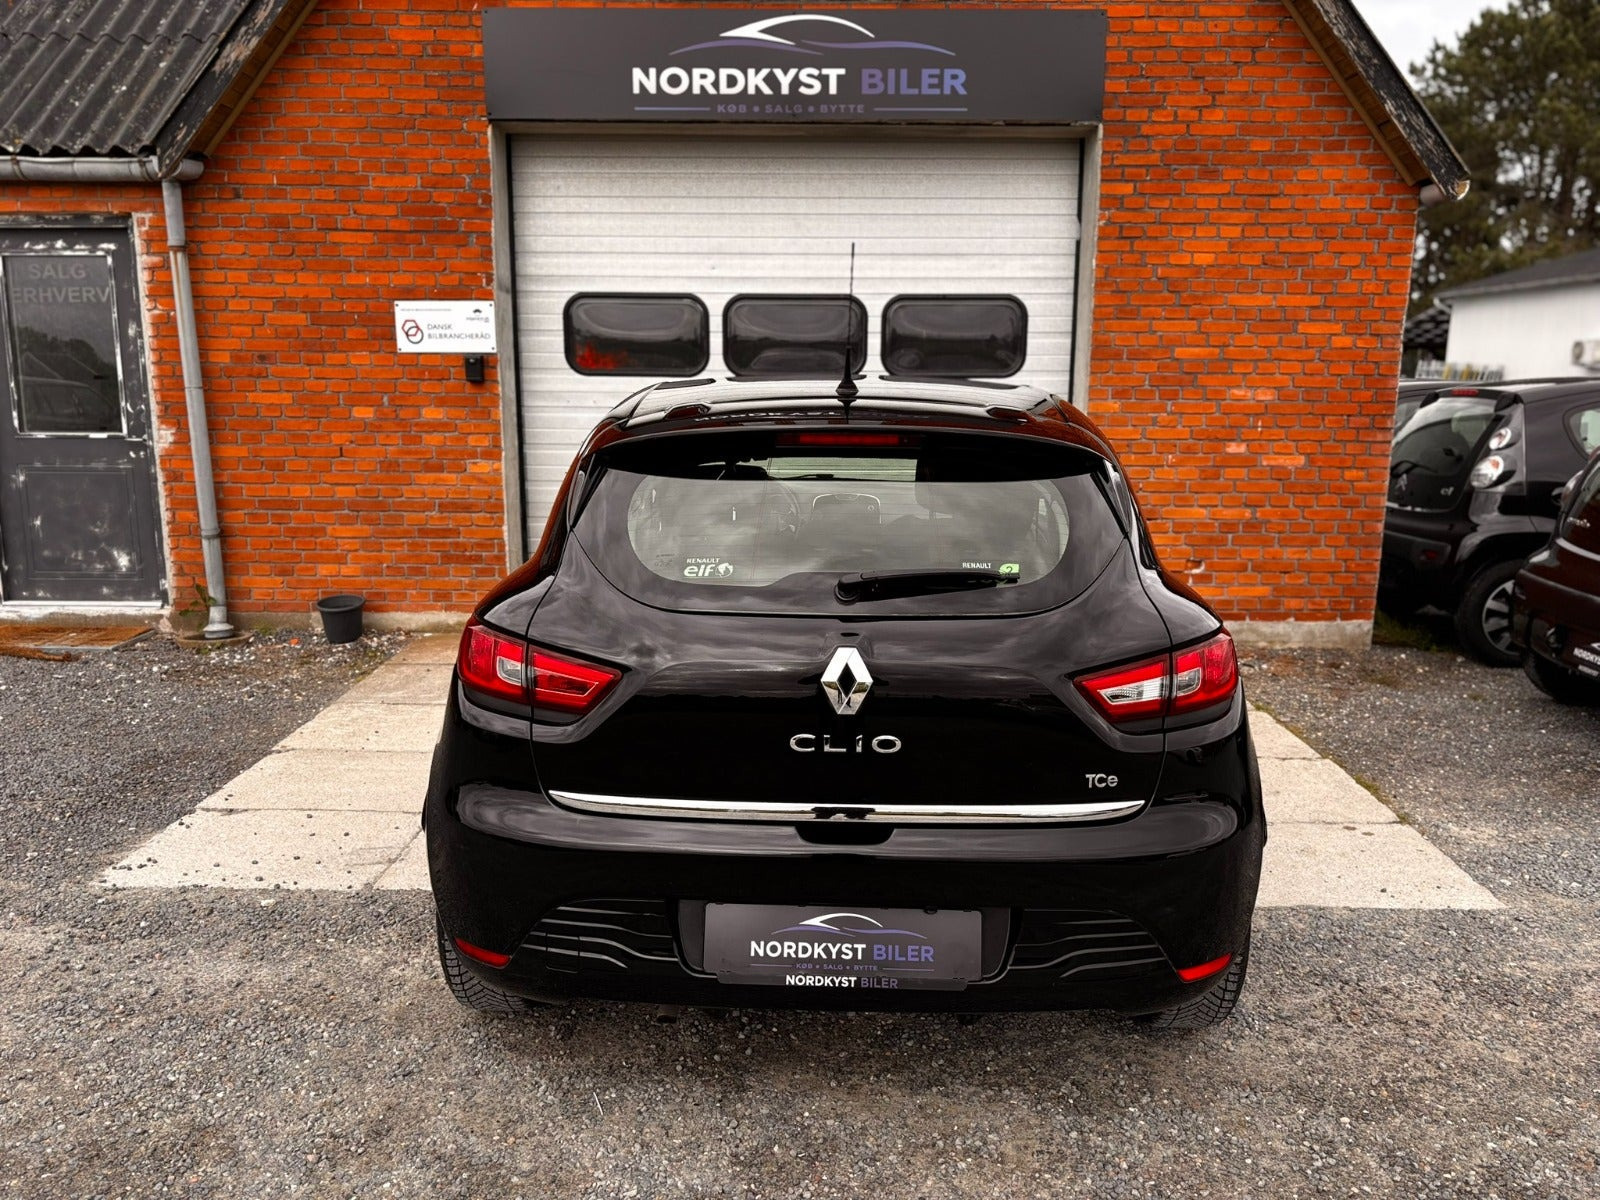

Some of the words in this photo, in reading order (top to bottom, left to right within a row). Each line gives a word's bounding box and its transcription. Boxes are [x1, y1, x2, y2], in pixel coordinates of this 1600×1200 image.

[632, 66, 846, 95] NORDKYST
[861, 68, 968, 95] BILER
[716, 104, 747, 114] KØB
[764, 104, 803, 114] SALG
[820, 104, 865, 114] BYTTE
[28, 263, 87, 279] SALG
[12, 286, 111, 303] ERHVERV
[427, 332, 492, 340] BILBRANCHERÅD
[683, 564, 716, 577] elf
[789, 733, 902, 753] CLIO
[1085, 773, 1119, 788] TCe
[750, 940, 867, 960] NORDKYST
[873, 944, 935, 962] BILER
[823, 963, 844, 971] SALG
[853, 964, 879, 972] BYTTE
[785, 974, 858, 988] NORDKYST
[860, 977, 899, 989] BILER
